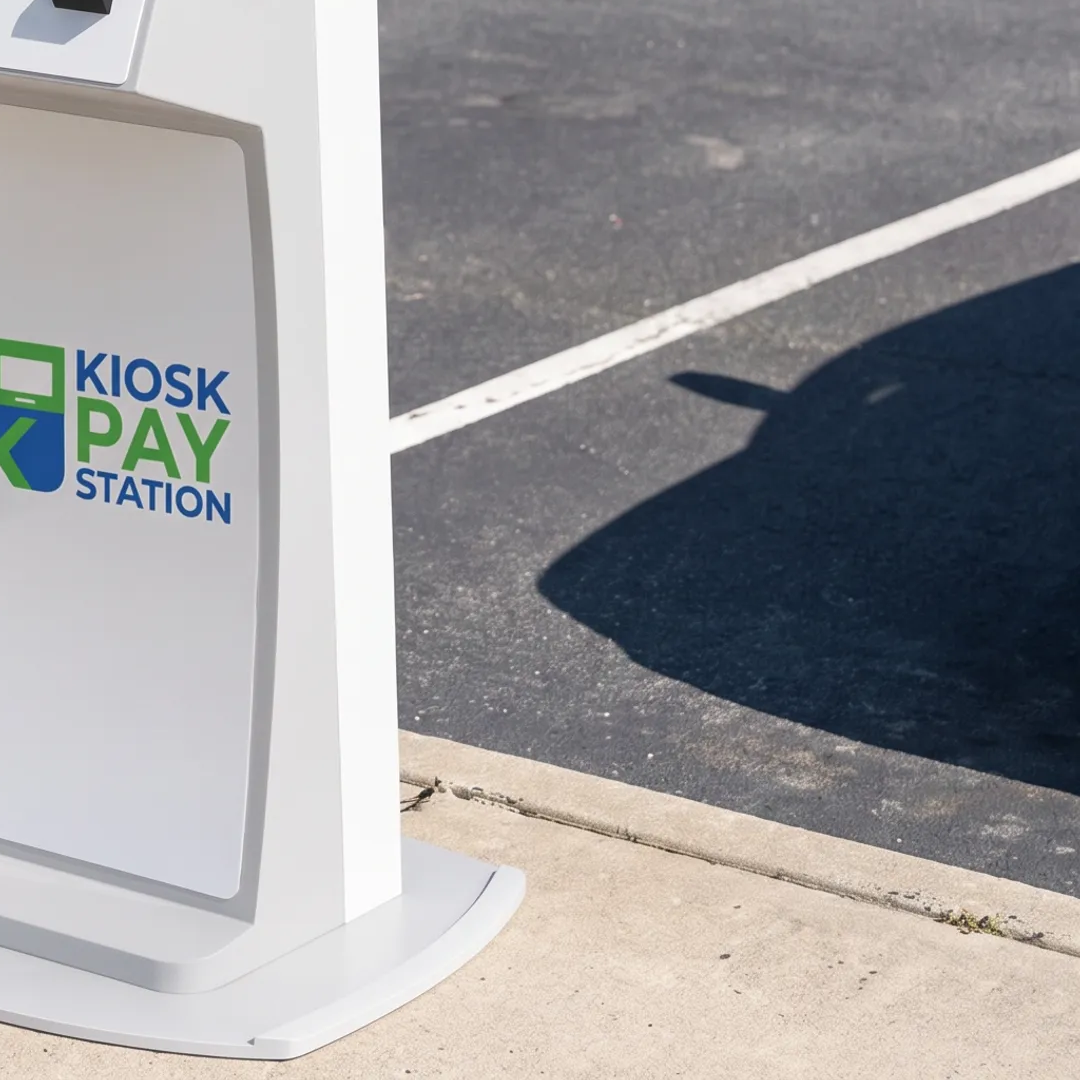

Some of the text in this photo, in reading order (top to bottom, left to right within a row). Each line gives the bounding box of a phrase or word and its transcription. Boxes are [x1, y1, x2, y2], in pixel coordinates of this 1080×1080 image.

[76, 349, 231, 415] KIOSK
[76, 396, 231, 483] PAY
[75, 467, 231, 525] STATION
